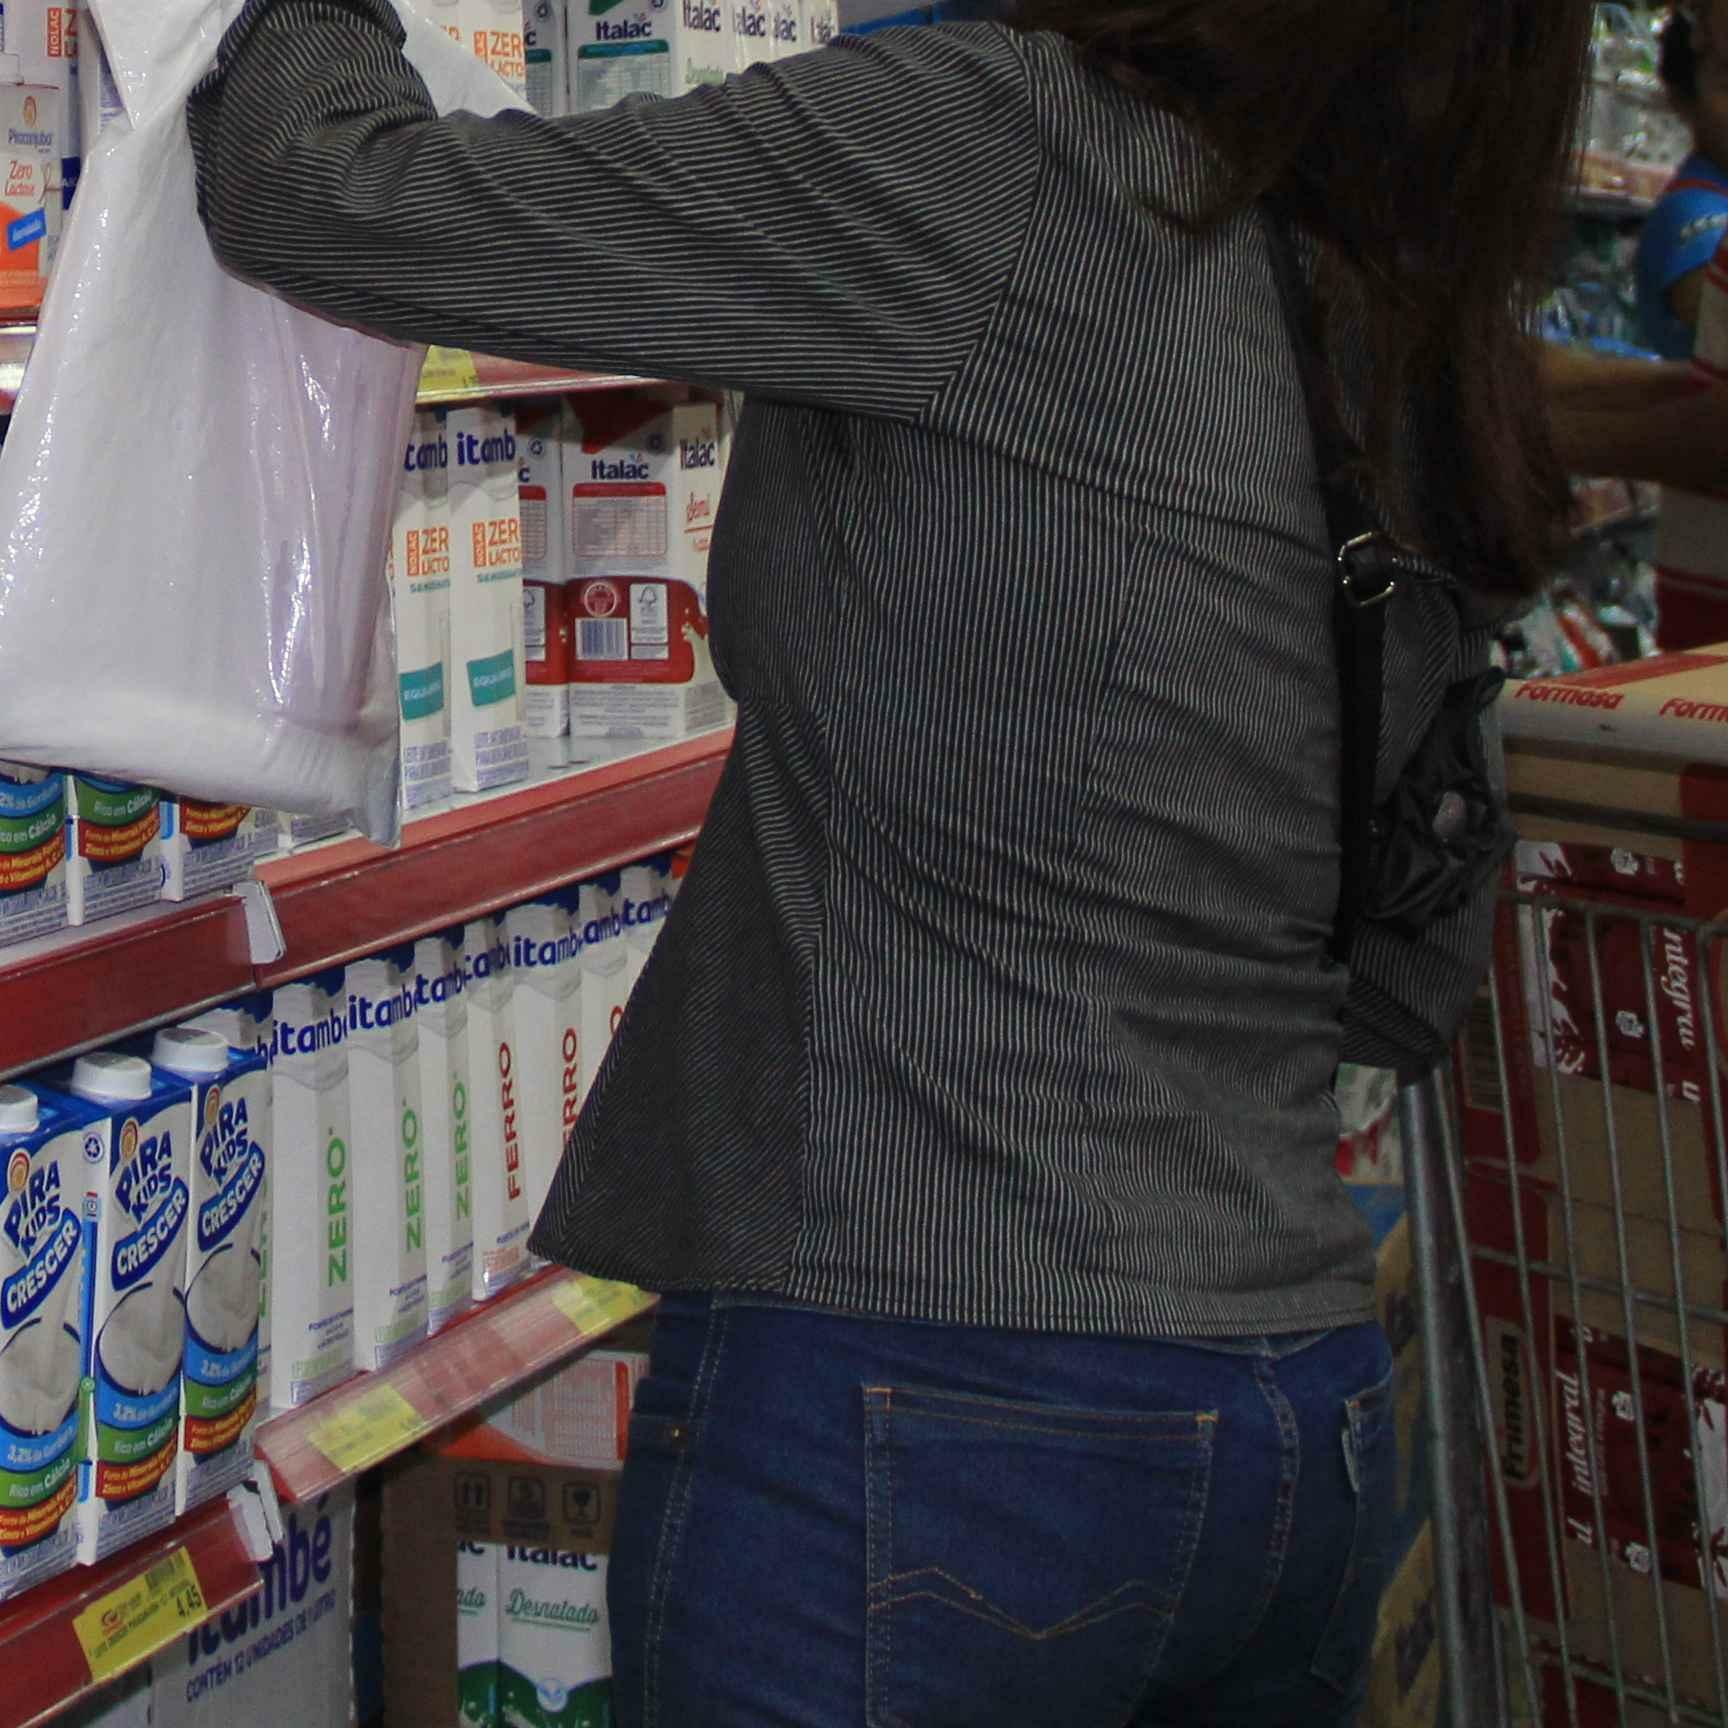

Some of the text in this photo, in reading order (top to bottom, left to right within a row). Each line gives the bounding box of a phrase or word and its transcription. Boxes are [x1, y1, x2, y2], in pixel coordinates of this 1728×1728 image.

[594, 17, 653, 43] Italac
[590, 454, 649, 481] Italac
[1515, 681, 1626, 711] Formosa
[200, 1097, 247, 1176] PIRA
[212, 1130, 248, 1188] KIDS
[452, 1080, 469, 1220] ZERO
[497, 1041, 520, 1200] FERRO
[2, 1159, 60, 1244] PIRA
[115, 1130, 172, 1216] PIRA
[129, 1162, 172, 1228] KIDS
[200, 1145, 263, 1236] CRESCER
[327, 1136, 348, 1287] ZERO
[400, 1108, 421, 1248] ZERO
[17, 1194, 61, 1260] KIDS
[115, 1184, 187, 1276] CRESCER
[5, 1220, 80, 1320] CRESCER
[175, 1583, 202, 1619] 4.45
[504, 1587, 599, 1630] Desnatado
